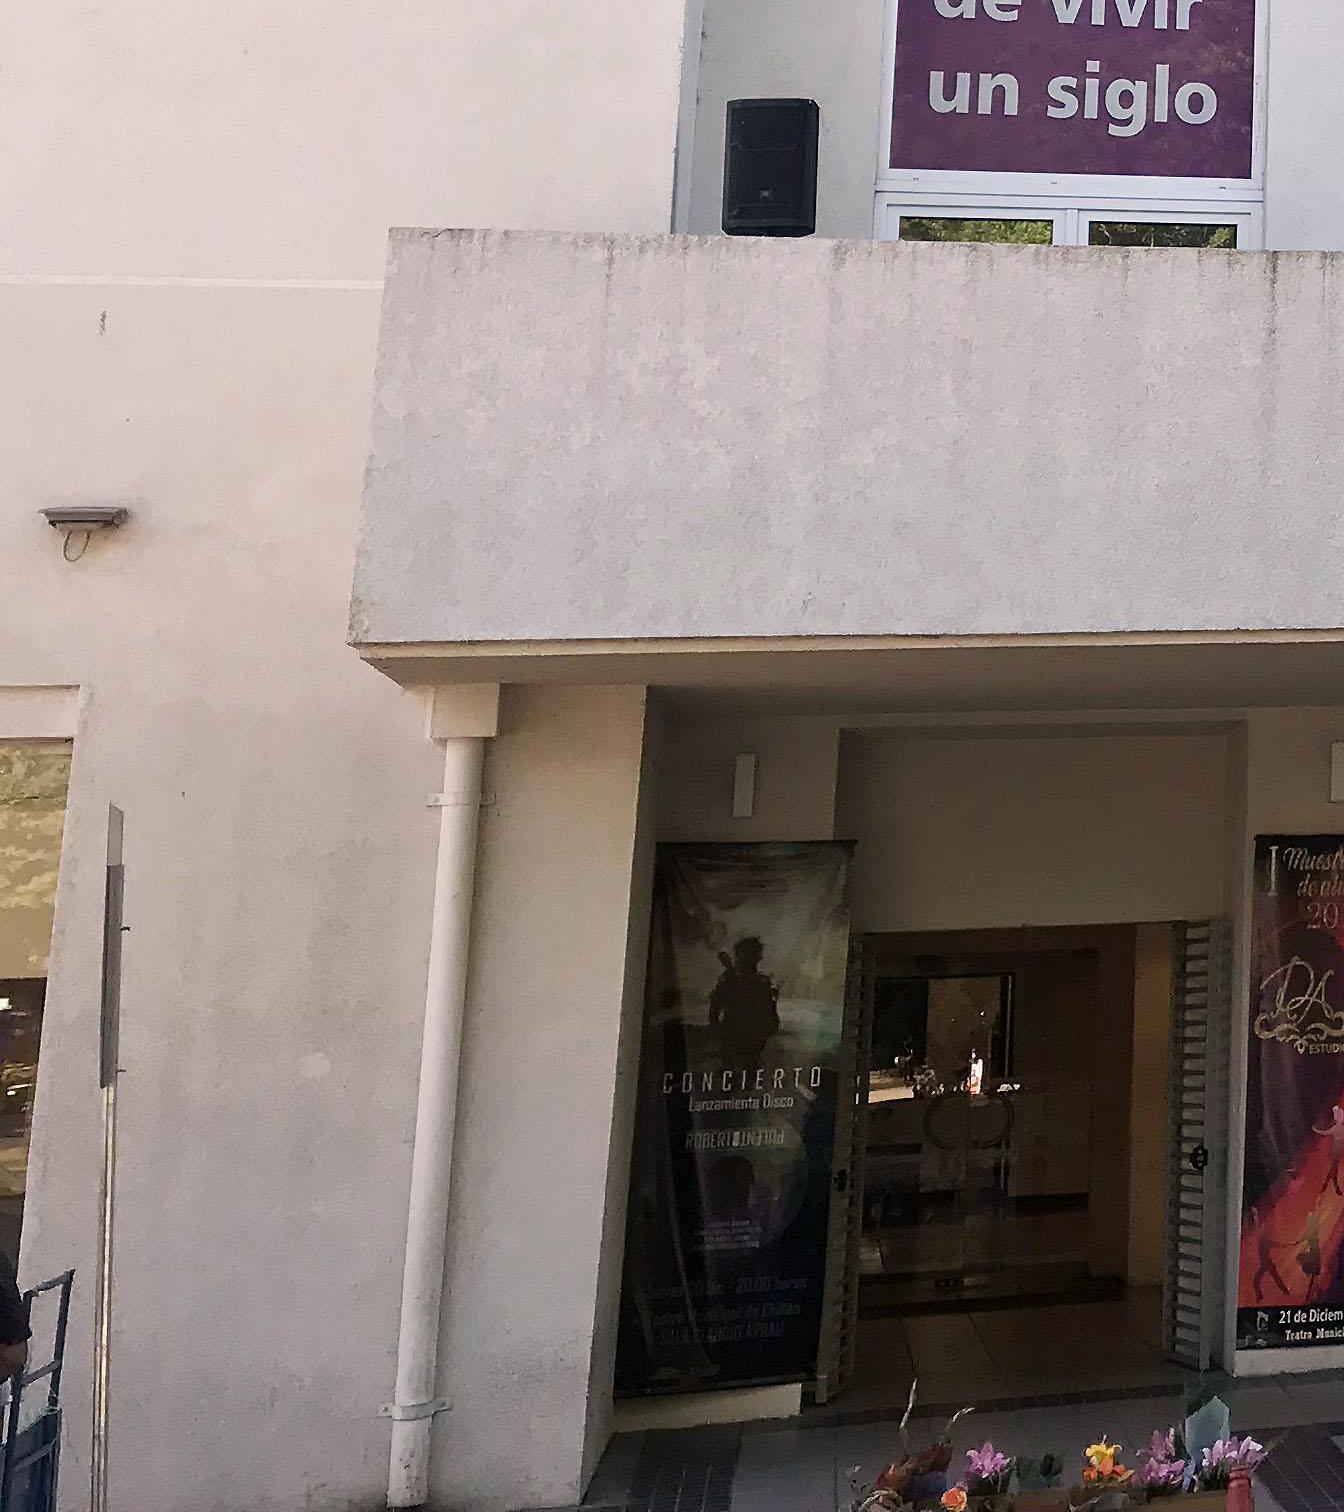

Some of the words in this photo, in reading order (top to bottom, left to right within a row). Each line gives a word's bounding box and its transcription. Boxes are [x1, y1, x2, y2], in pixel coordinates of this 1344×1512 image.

[927, 67, 1020, 117] un
[1046, 59, 1218, 138] siglo
[662, 1066, 822, 1095] CONCIERTO
[1278, 1310, 1292, 1325] 21
[1293, 1309, 1308, 1324] de
